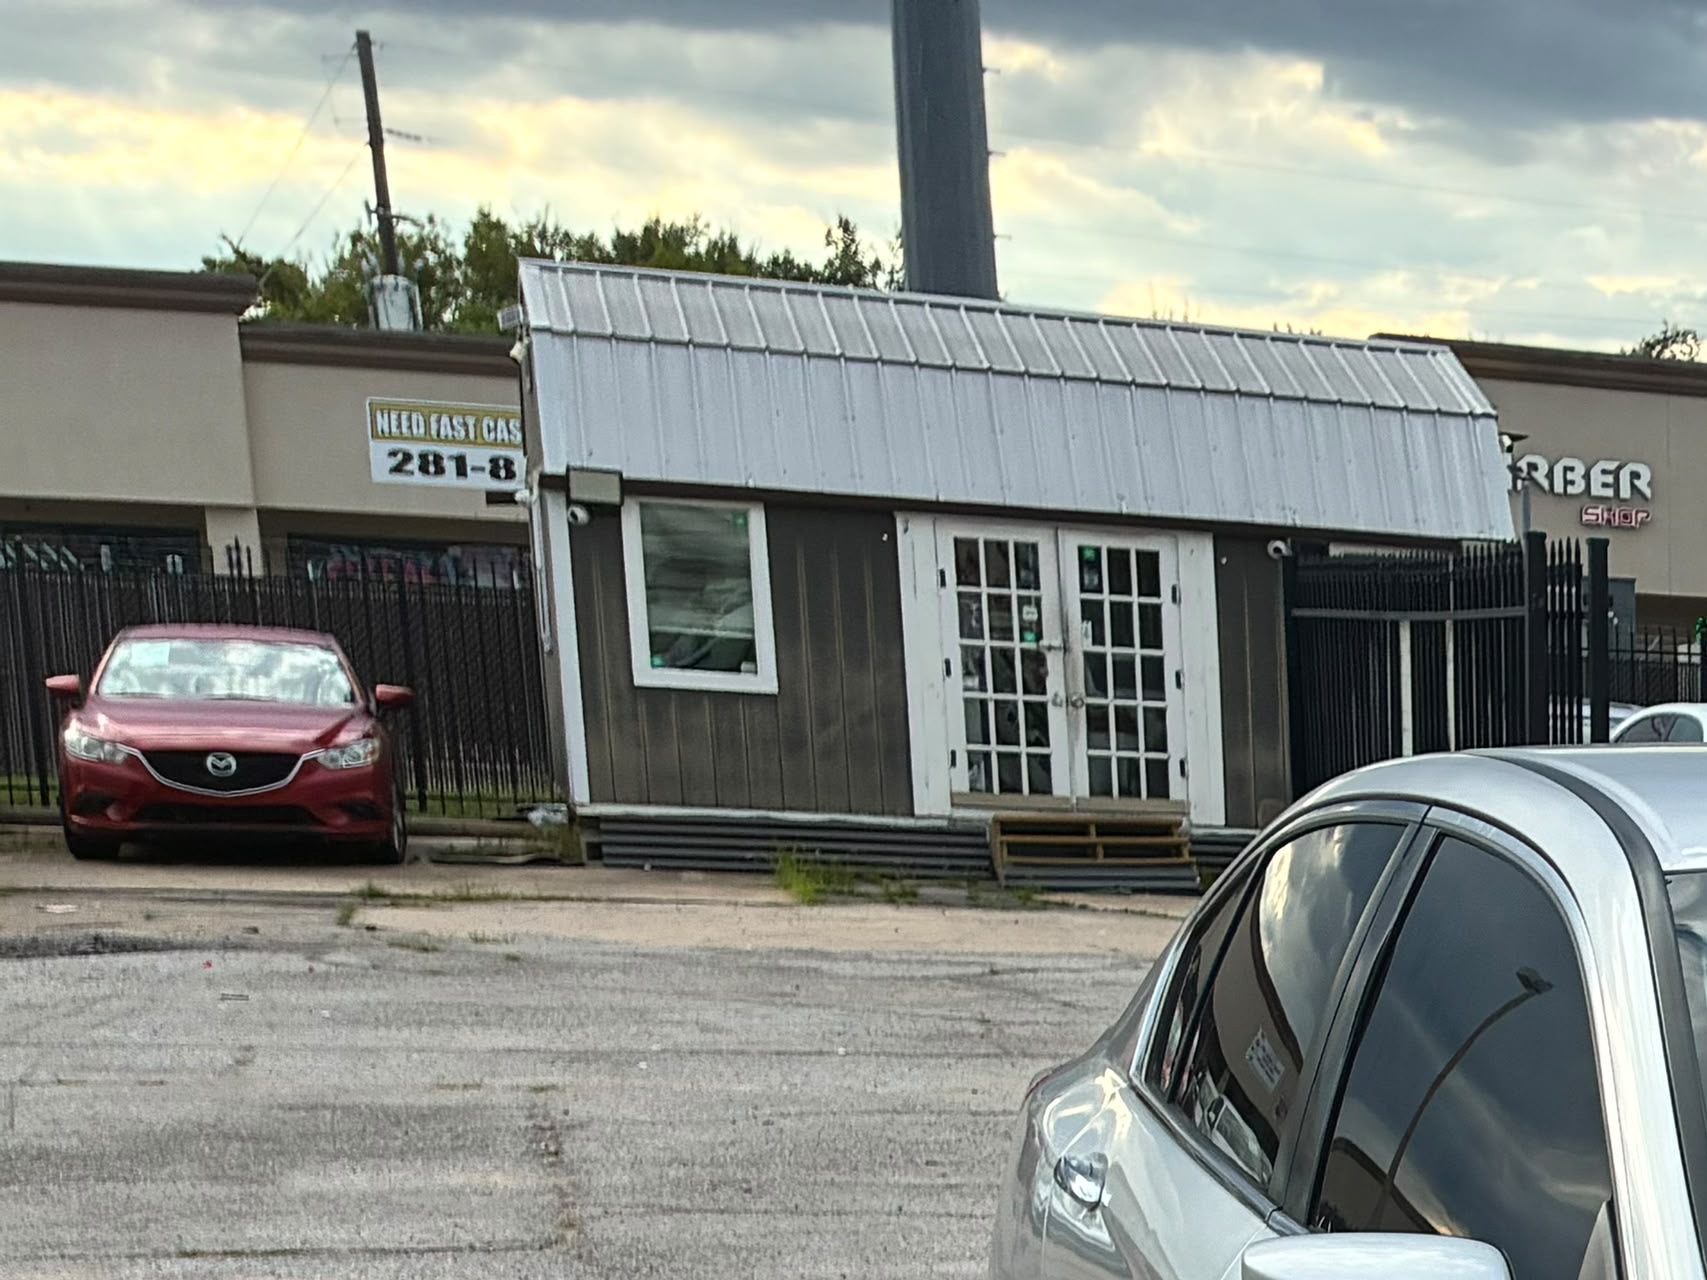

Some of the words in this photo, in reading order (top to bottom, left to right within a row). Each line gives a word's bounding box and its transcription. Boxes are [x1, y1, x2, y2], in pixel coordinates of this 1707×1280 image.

[376, 409, 426, 437] NEED
[430, 413, 477, 440] FAST
[387, 447, 517, 481] 281-8
[1507, 453, 1652, 501] RBER
[1581, 503, 1650, 528] SHOP
